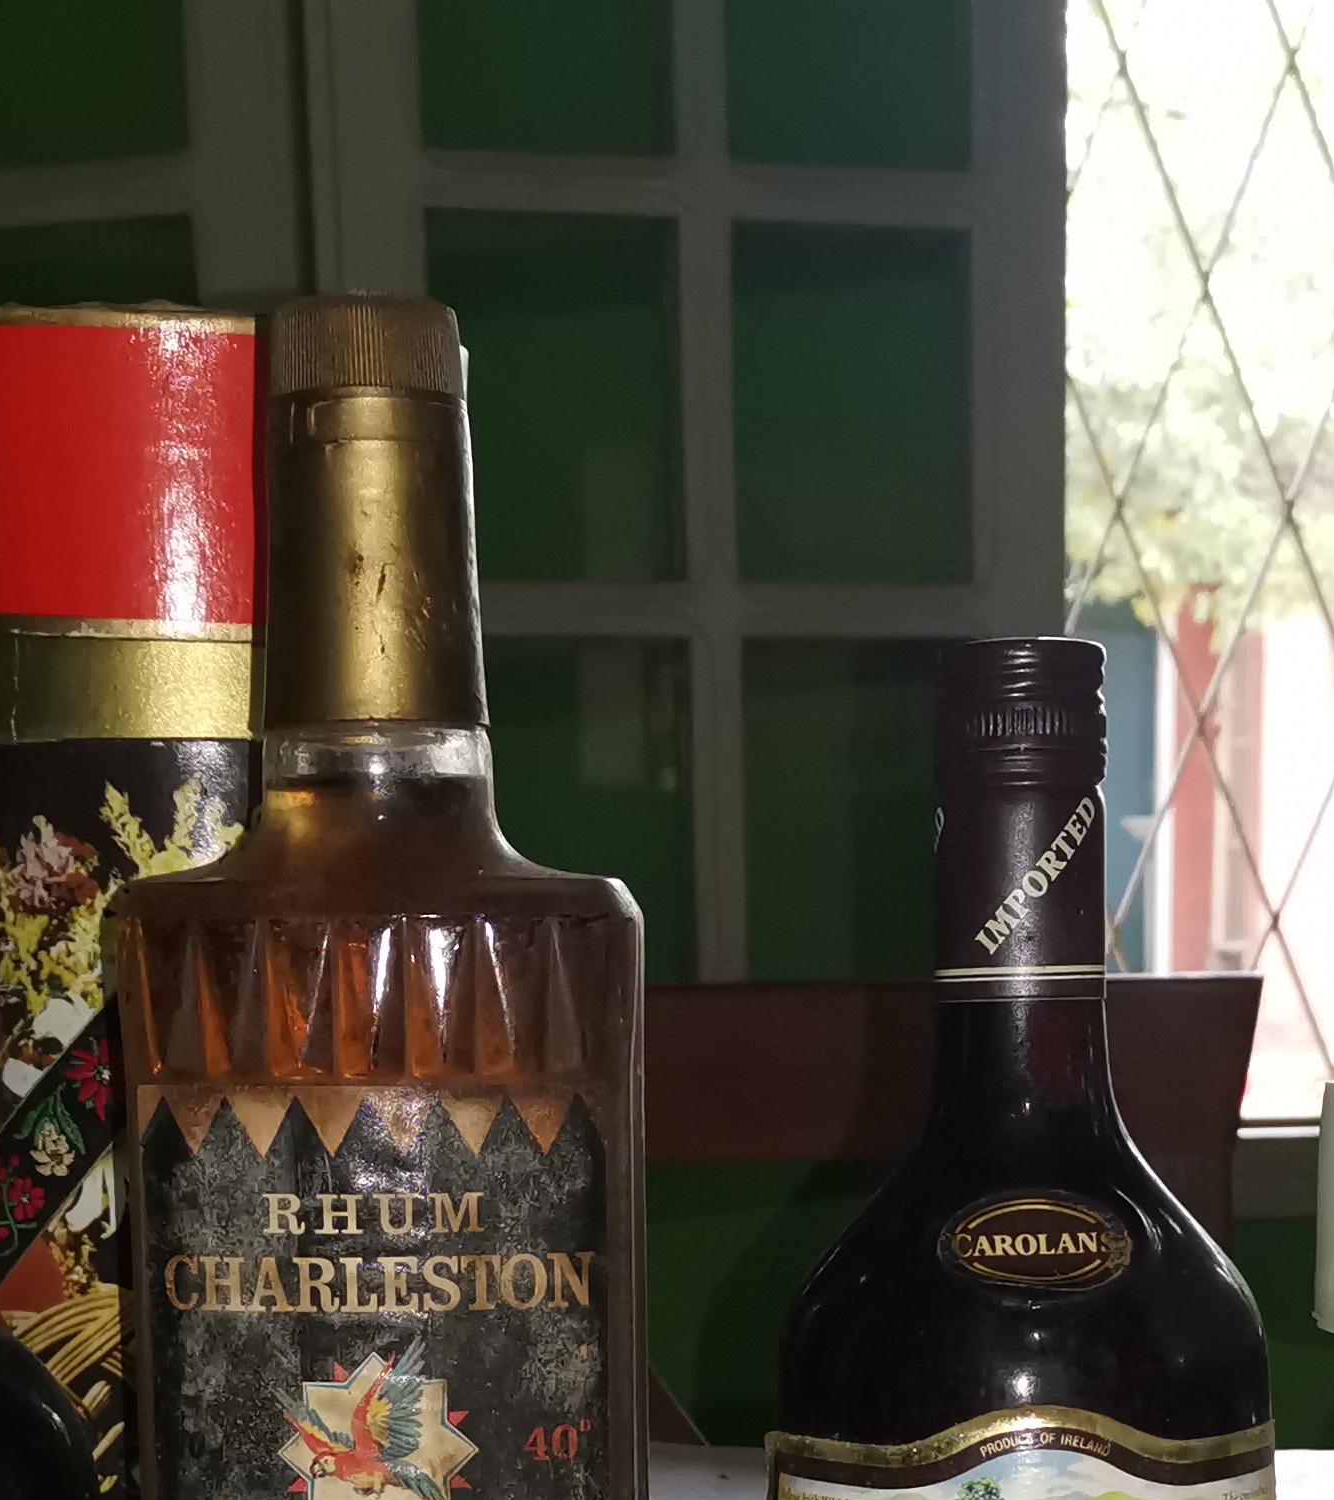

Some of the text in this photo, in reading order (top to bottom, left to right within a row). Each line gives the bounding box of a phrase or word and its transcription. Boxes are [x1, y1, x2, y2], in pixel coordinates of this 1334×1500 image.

[975, 796, 1096, 955] IMPORTED
[262, 1191, 489, 1235] RHUM
[163, 1250, 596, 1313] CHARLESTON
[1040, 1431, 1056, 1445] OF
[1061, 1433, 1112, 1457] IRELAND
